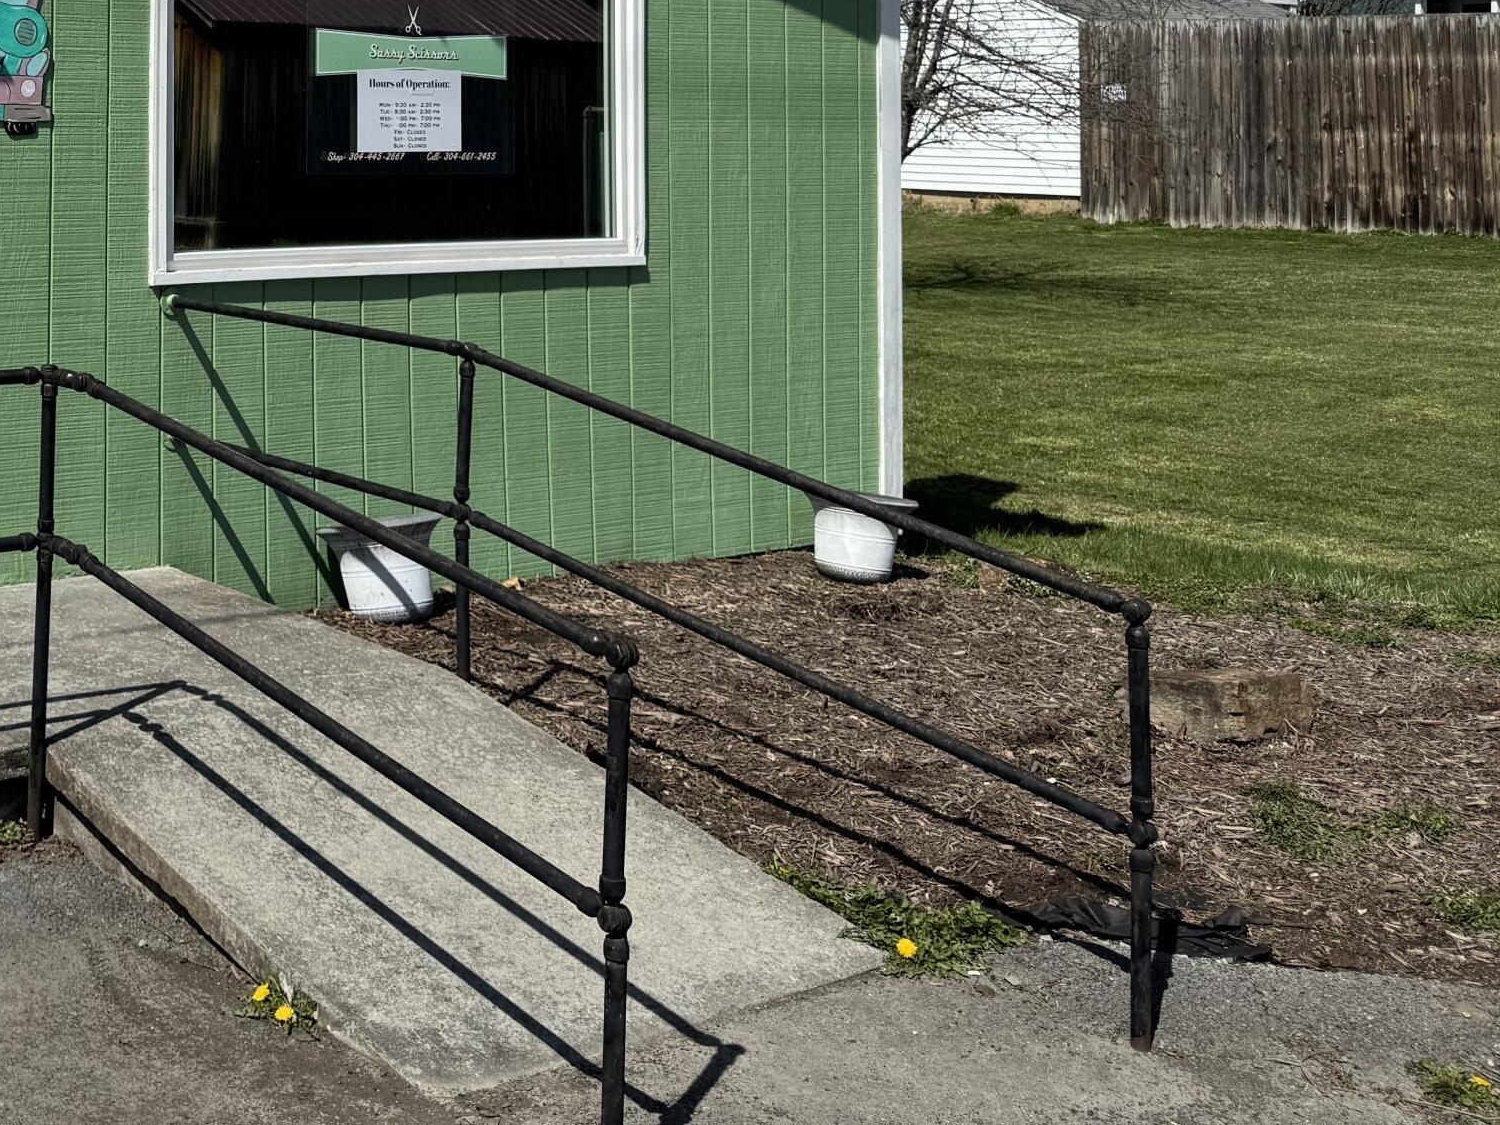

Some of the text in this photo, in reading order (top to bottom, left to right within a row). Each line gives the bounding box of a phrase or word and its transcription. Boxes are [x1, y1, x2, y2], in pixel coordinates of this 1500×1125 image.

[369, 43, 460, 65] Sassy Scissors
[369, 78, 450, 91] Hours of Operation:
[348, 152, 406, 162] 304-445-2667
[443, 151, 497, 162] 304-661-2455
